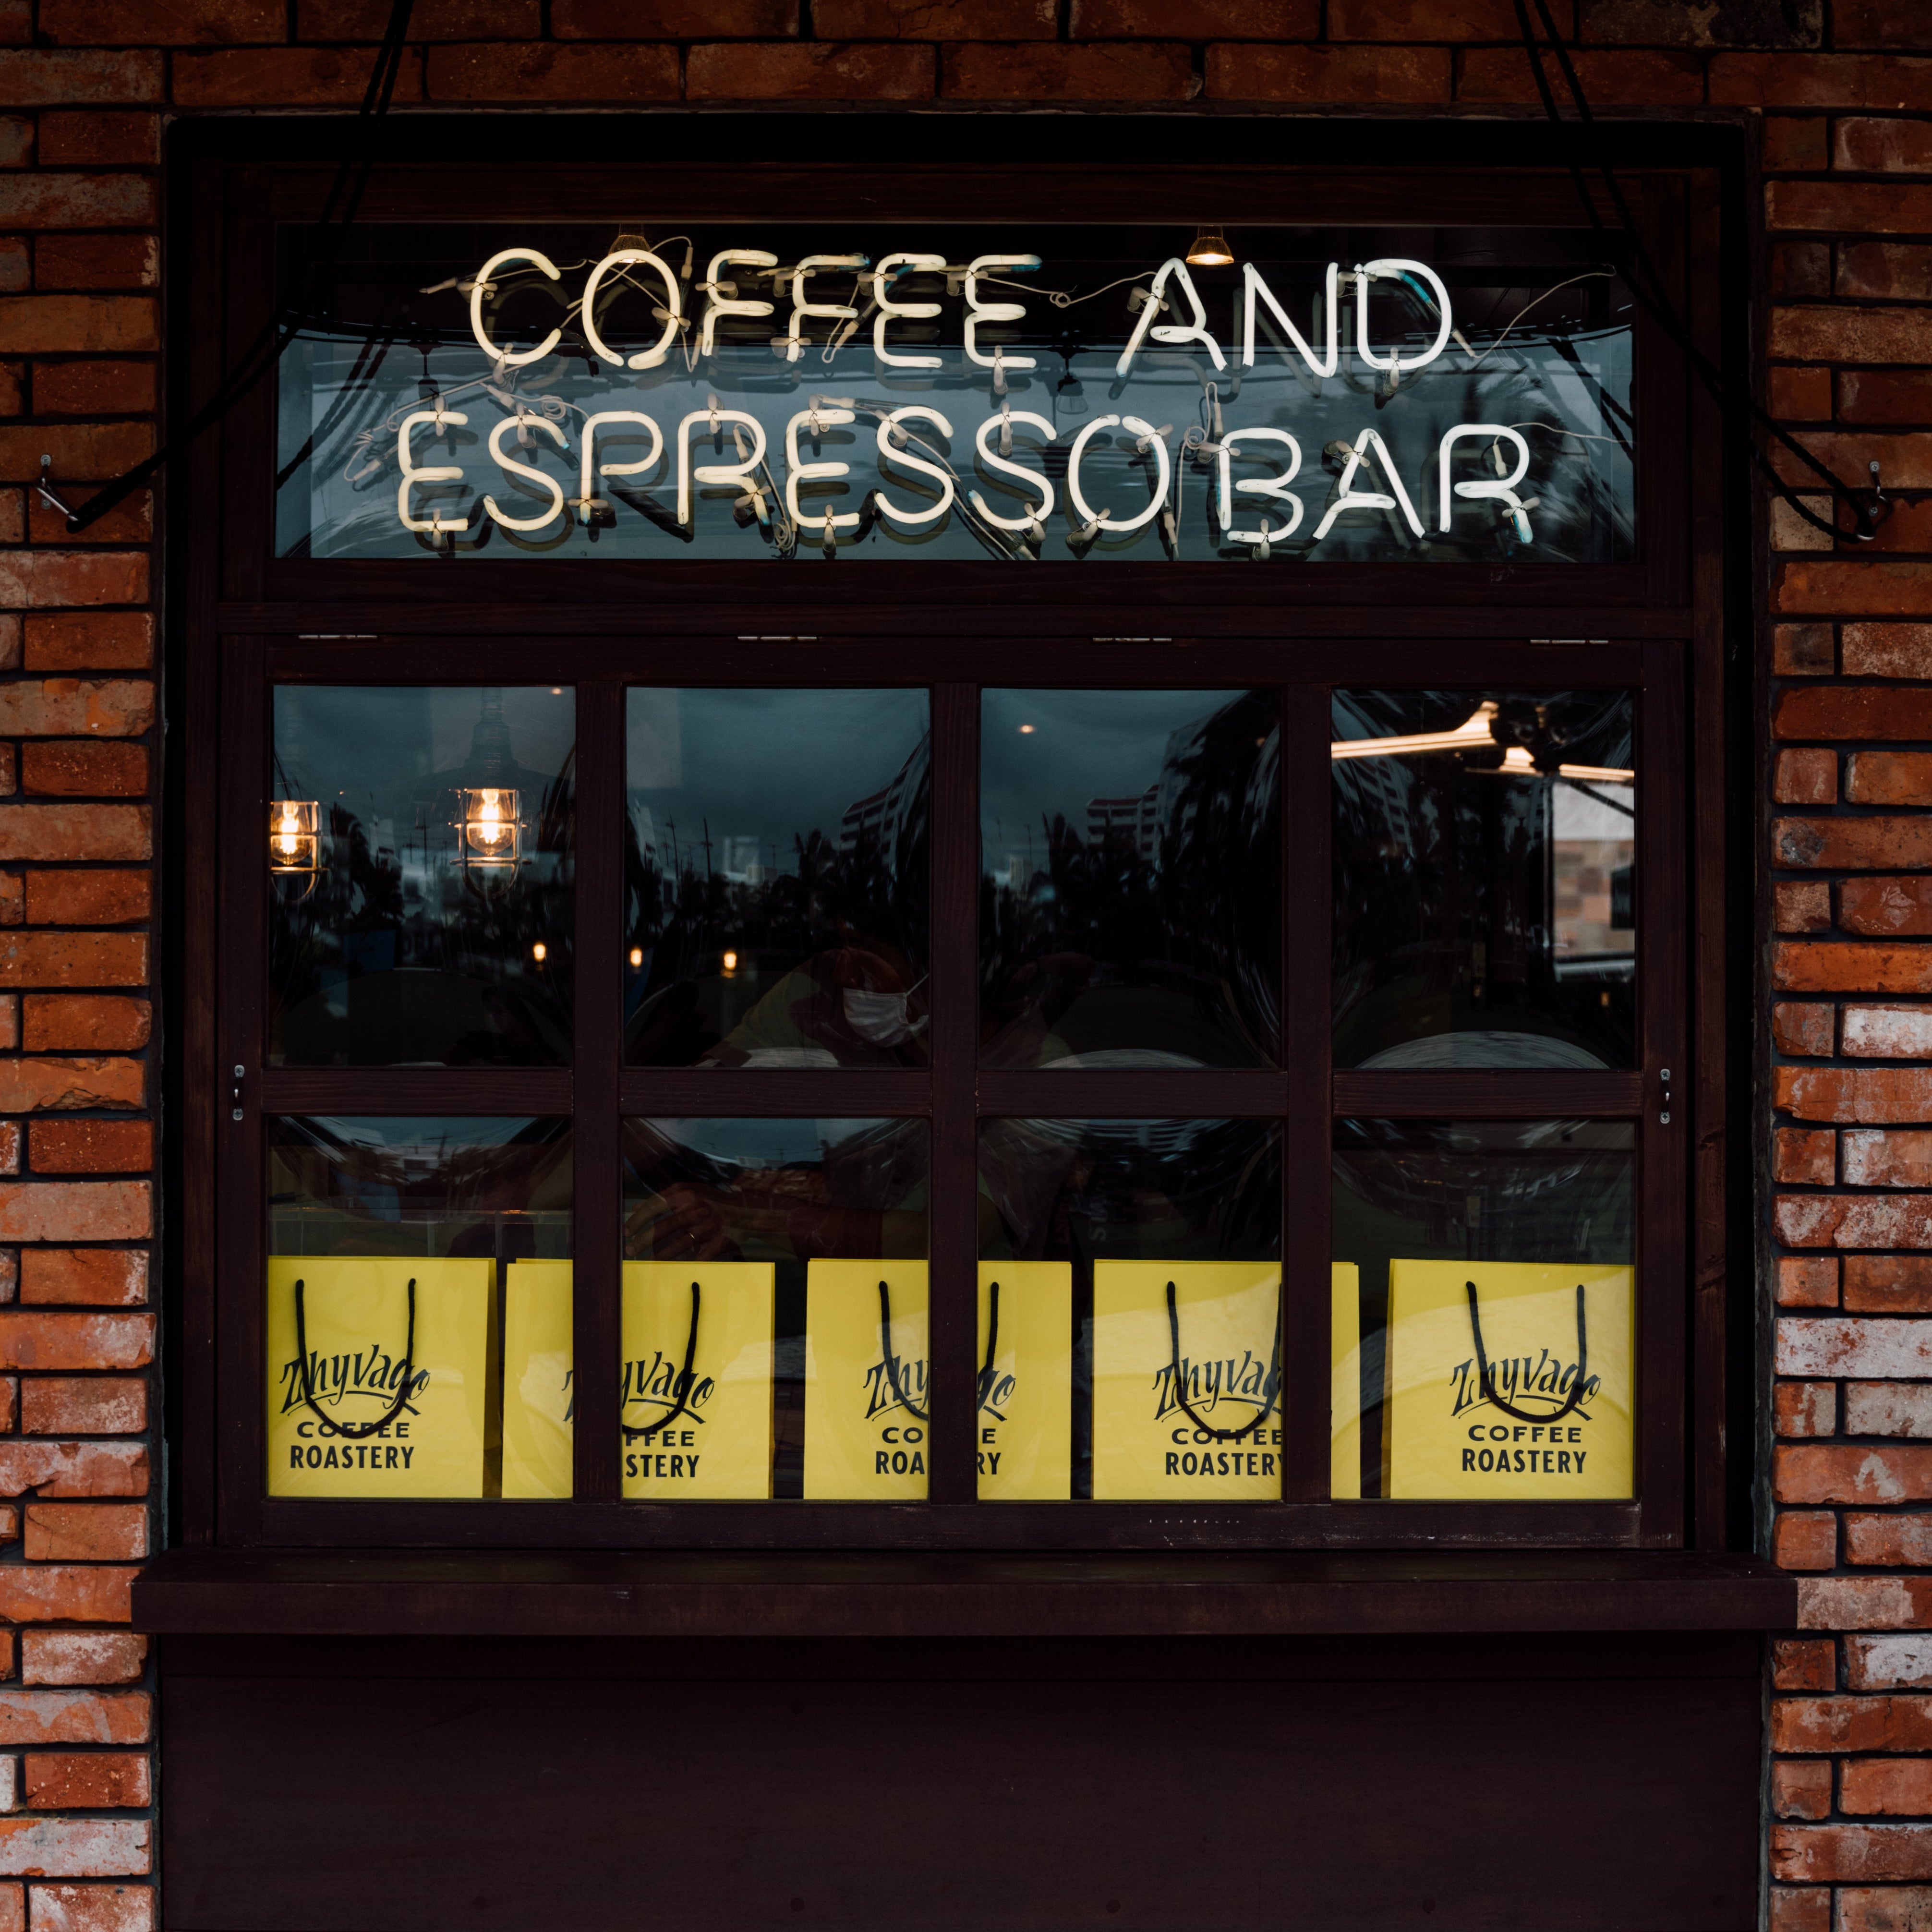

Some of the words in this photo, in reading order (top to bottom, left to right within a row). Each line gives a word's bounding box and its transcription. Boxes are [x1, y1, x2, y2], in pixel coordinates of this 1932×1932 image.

[471, 247, 1042, 369] COFFEE
[1116, 257, 1451, 378] AND
[398, 404, 1170, 531] ESPRESSO
[1216, 423, 1533, 543] BAR
[1152, 1350, 1281, 1423] Zhyva
[625, 1430, 695, 1447] FFEE
[881, 1427, 996, 1444] COE
[1468, 1425, 1582, 1443] COFFEE
[290, 1445, 414, 1469] ROASTERY
[626, 1454, 700, 1478] STERY
[876, 1451, 1001, 1475] ROARY
[1165, 1452, 1281, 1475] ROASTER
[1462, 1448, 1587, 1473] ROASTERY
